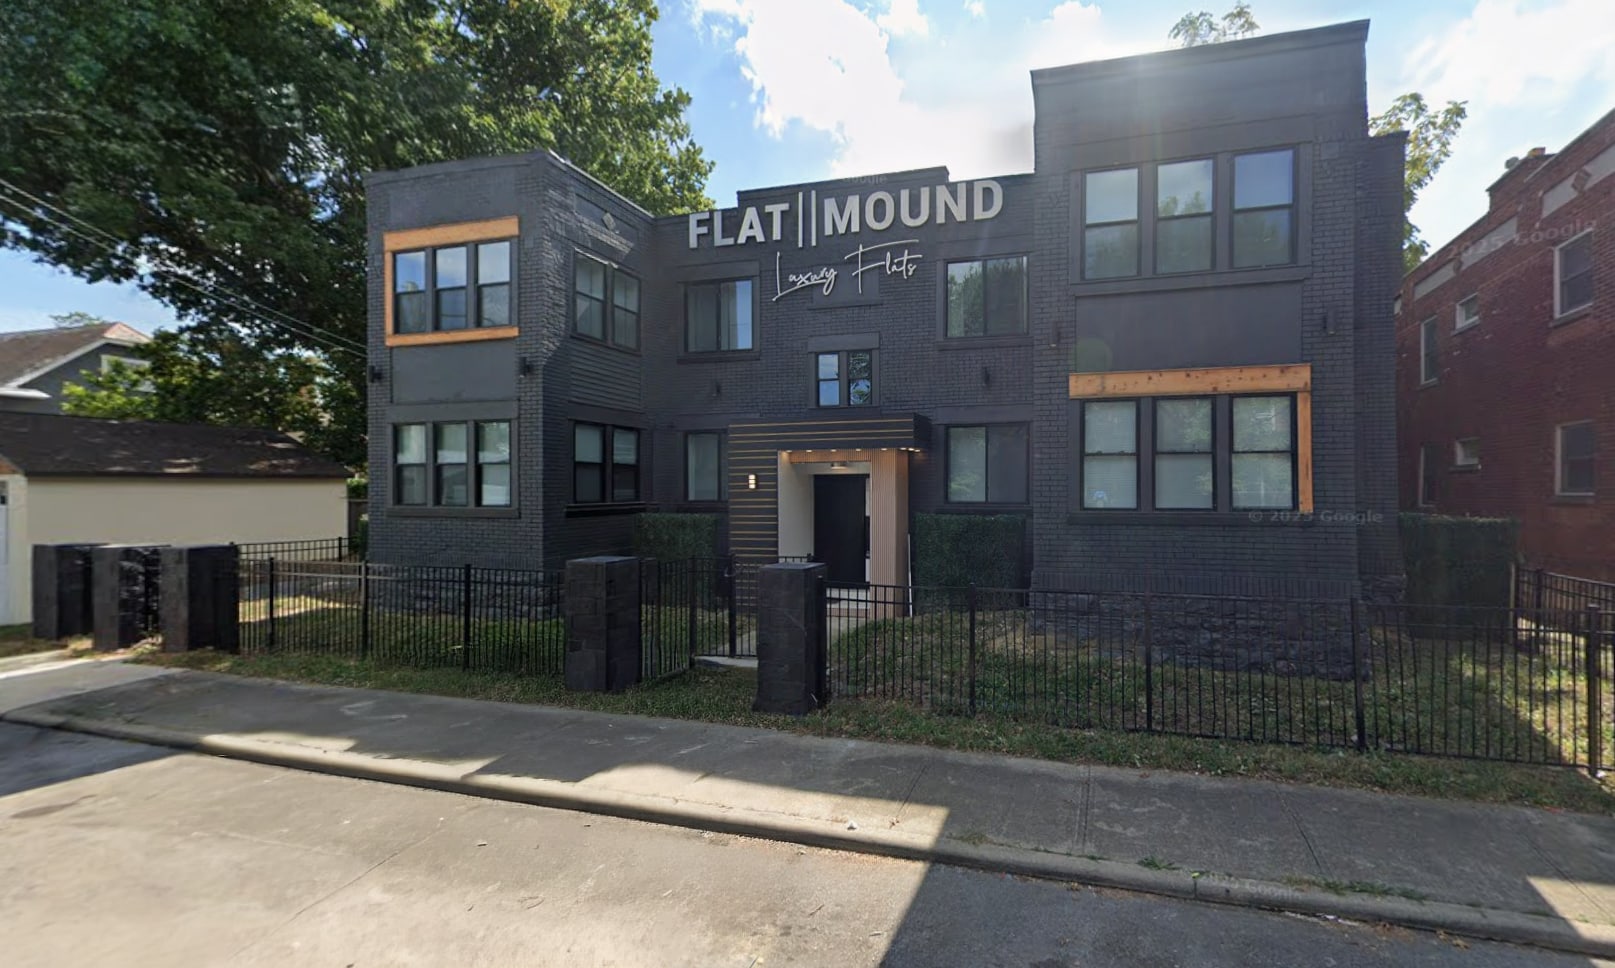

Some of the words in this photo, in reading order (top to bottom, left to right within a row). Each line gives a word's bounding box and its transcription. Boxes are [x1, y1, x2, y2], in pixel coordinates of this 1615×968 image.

[688, 202, 790, 249] FLAT
[823, 179, 1005, 237] MOUND
[772, 251, 838, 301] Luxury
[844, 239, 923, 294] Flats
